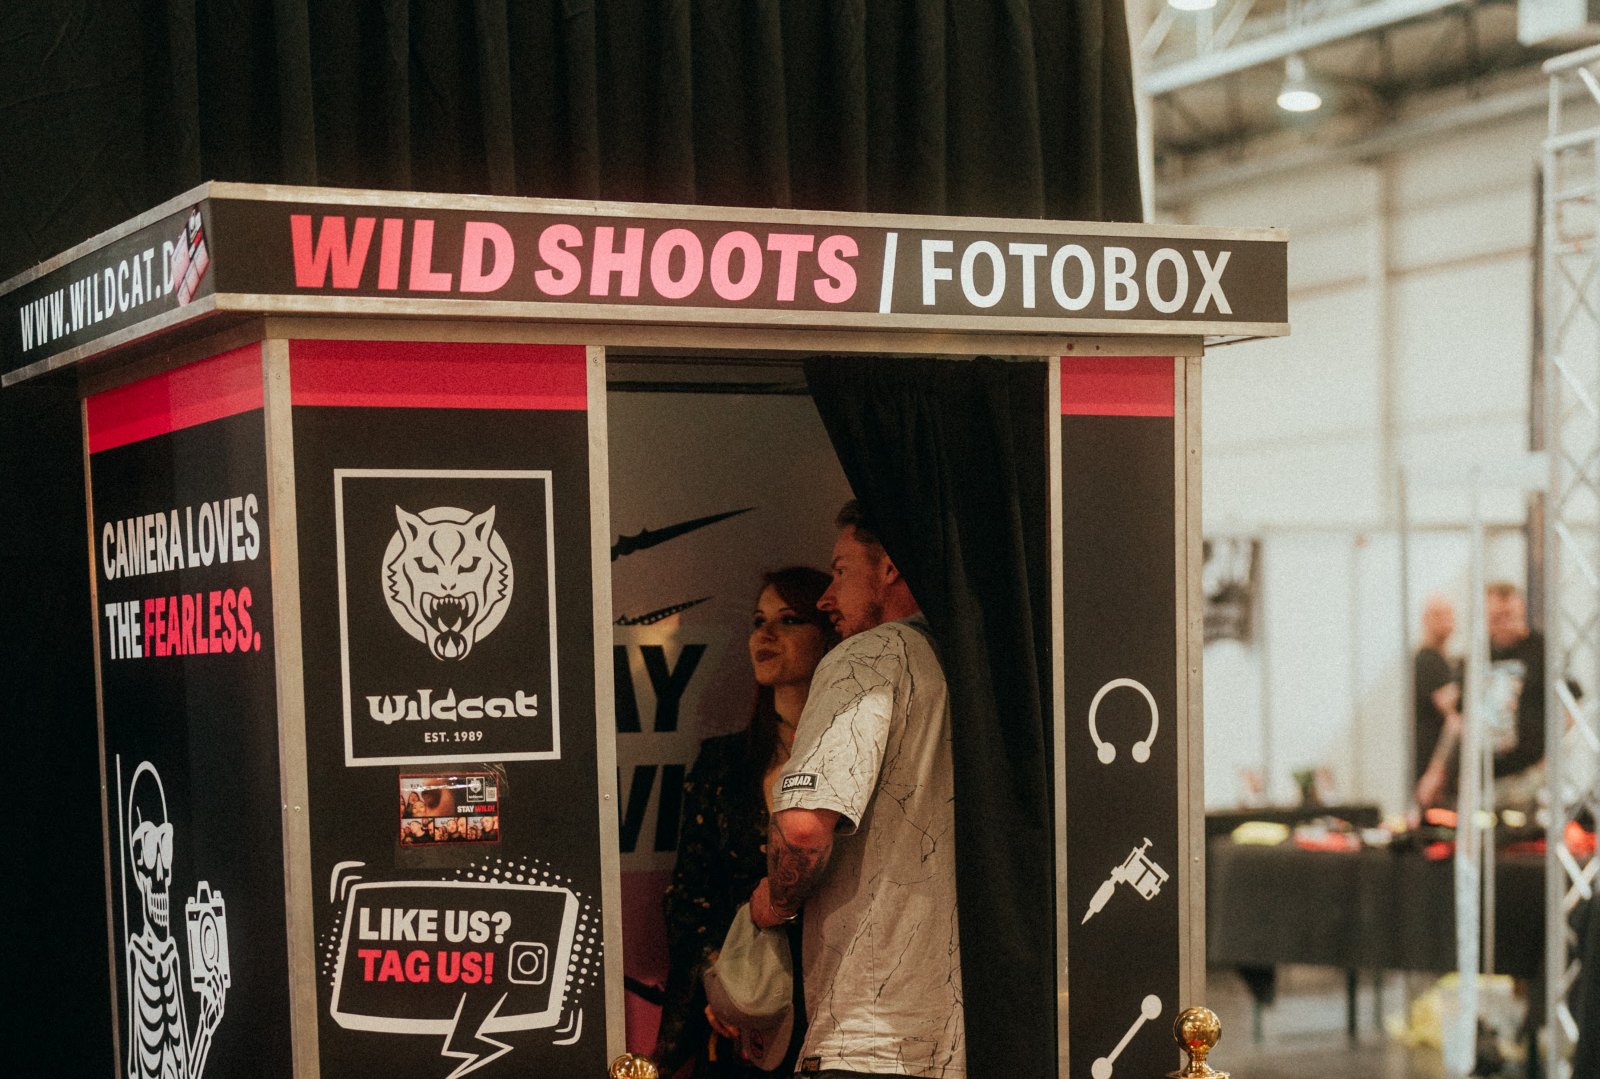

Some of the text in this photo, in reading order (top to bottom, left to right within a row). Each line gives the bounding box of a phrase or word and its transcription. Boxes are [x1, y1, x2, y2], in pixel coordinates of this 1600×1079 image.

[290, 214, 1233, 315] WILD SHOOTS / FOTOBOX
[102, 493, 260, 581] CAMERA LOVES
[105, 586, 261, 660] THE FEARLESS.
[424, 731, 483, 743] EST. 1989
[457, 805, 474, 813] STAY
[358, 907, 512, 944] LIKE US?
[358, 949, 495, 985] TAG US!
